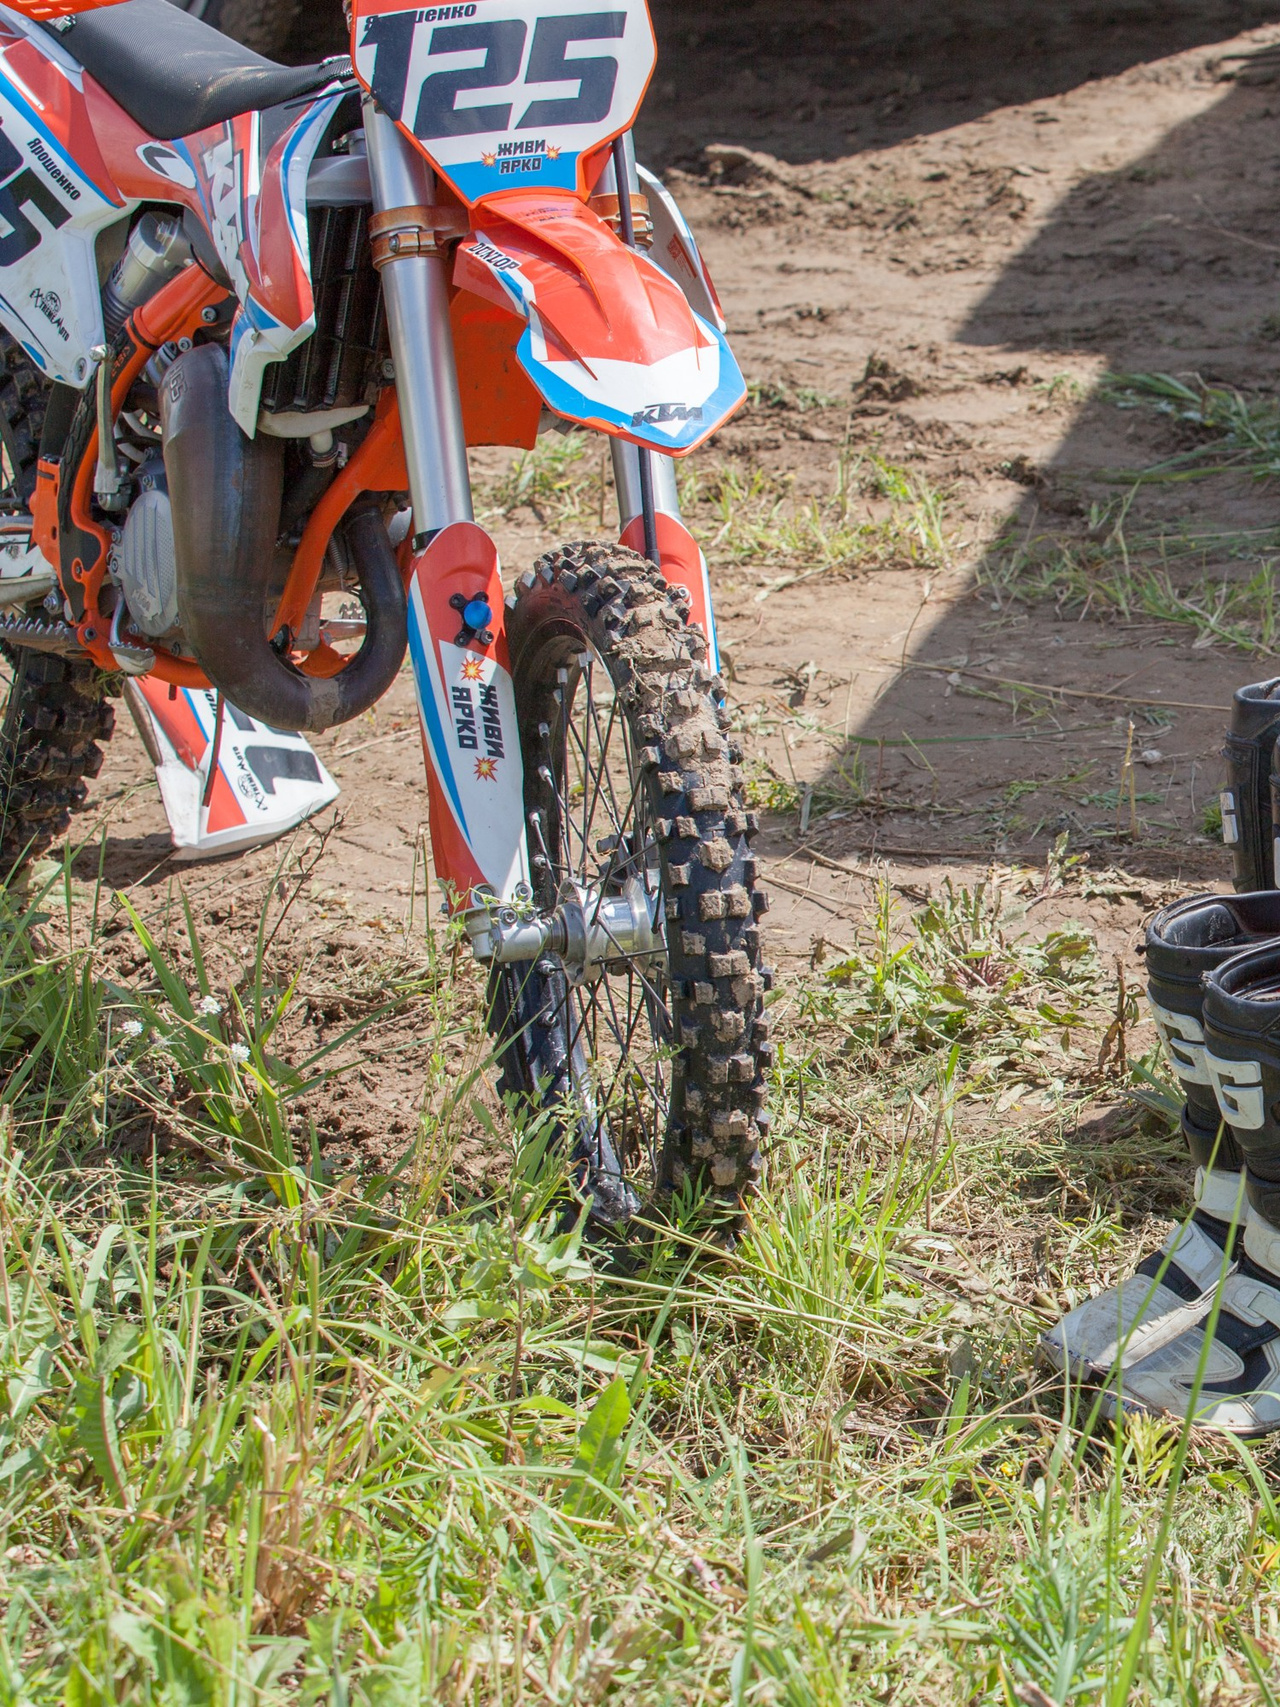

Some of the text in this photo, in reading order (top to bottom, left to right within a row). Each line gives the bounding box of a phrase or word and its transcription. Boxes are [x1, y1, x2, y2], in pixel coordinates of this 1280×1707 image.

[359, 11, 628, 141] 125
[27, 137, 82, 201] Ярошенко
[498, 139, 546, 157] ЖИВИ
[499, 157, 542, 175] ЯРКО
[467, 242, 520, 272] DUNLOP
[631, 402, 703, 428] KTM
[451, 686, 478, 750] ЯРКО
[480, 683, 505, 758] ЖИВИ
